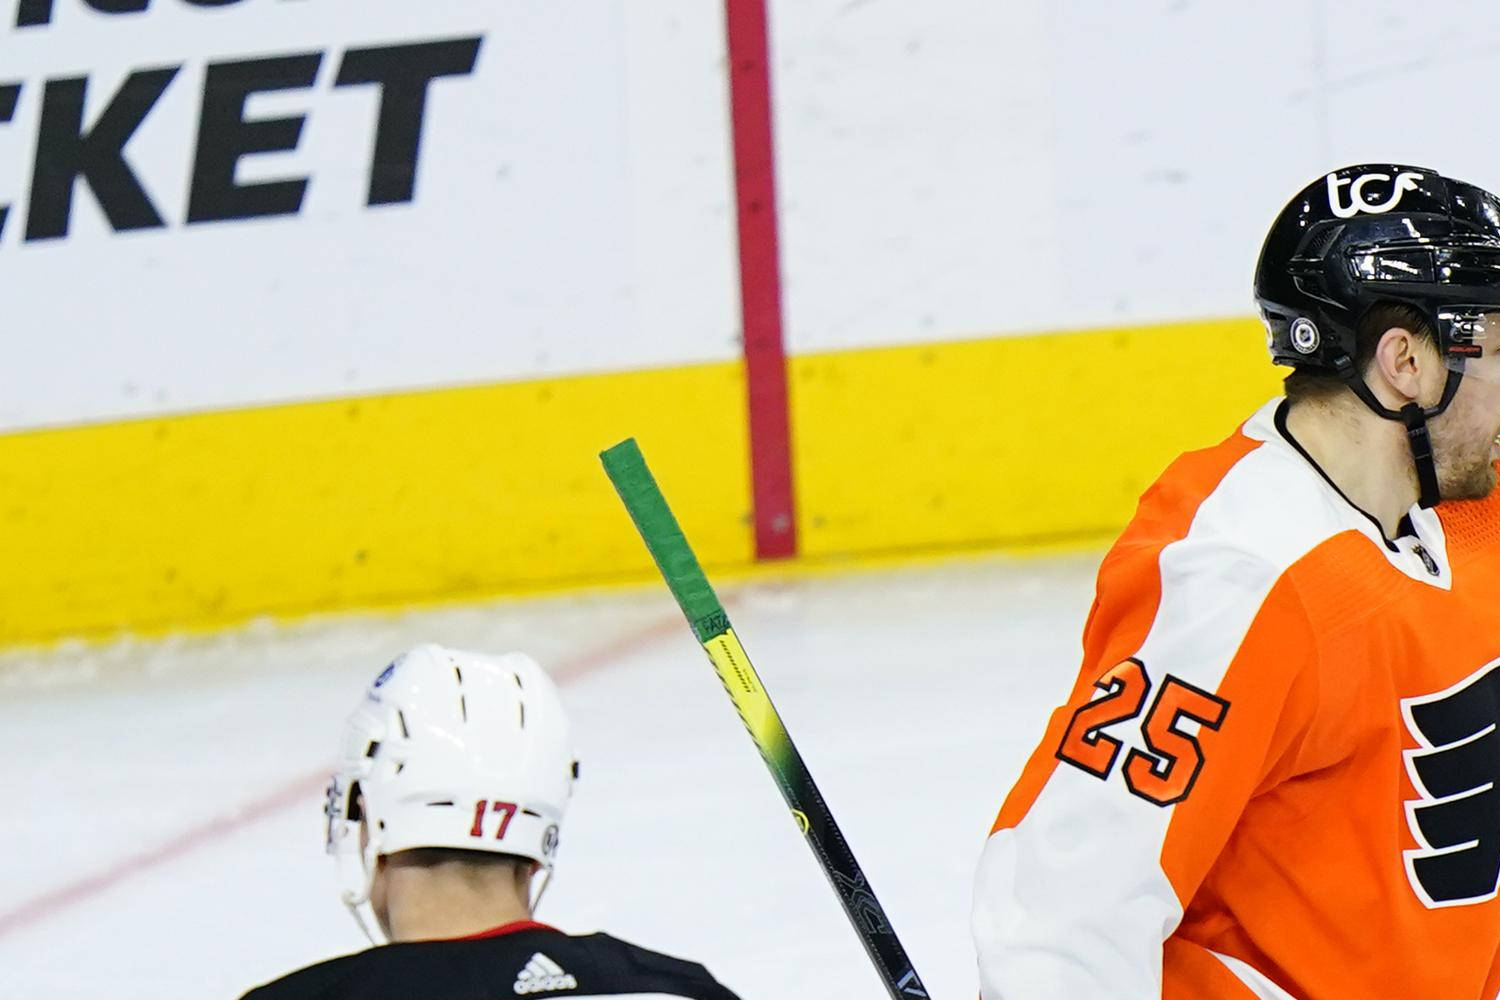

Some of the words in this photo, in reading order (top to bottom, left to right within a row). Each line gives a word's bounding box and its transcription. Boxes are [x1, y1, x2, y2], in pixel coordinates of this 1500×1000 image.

[0, 35, 484, 248] KET
[1054, 656, 1232, 808] 25
[469, 799, 518, 841] 17
[513, 973, 577, 995] adidas
